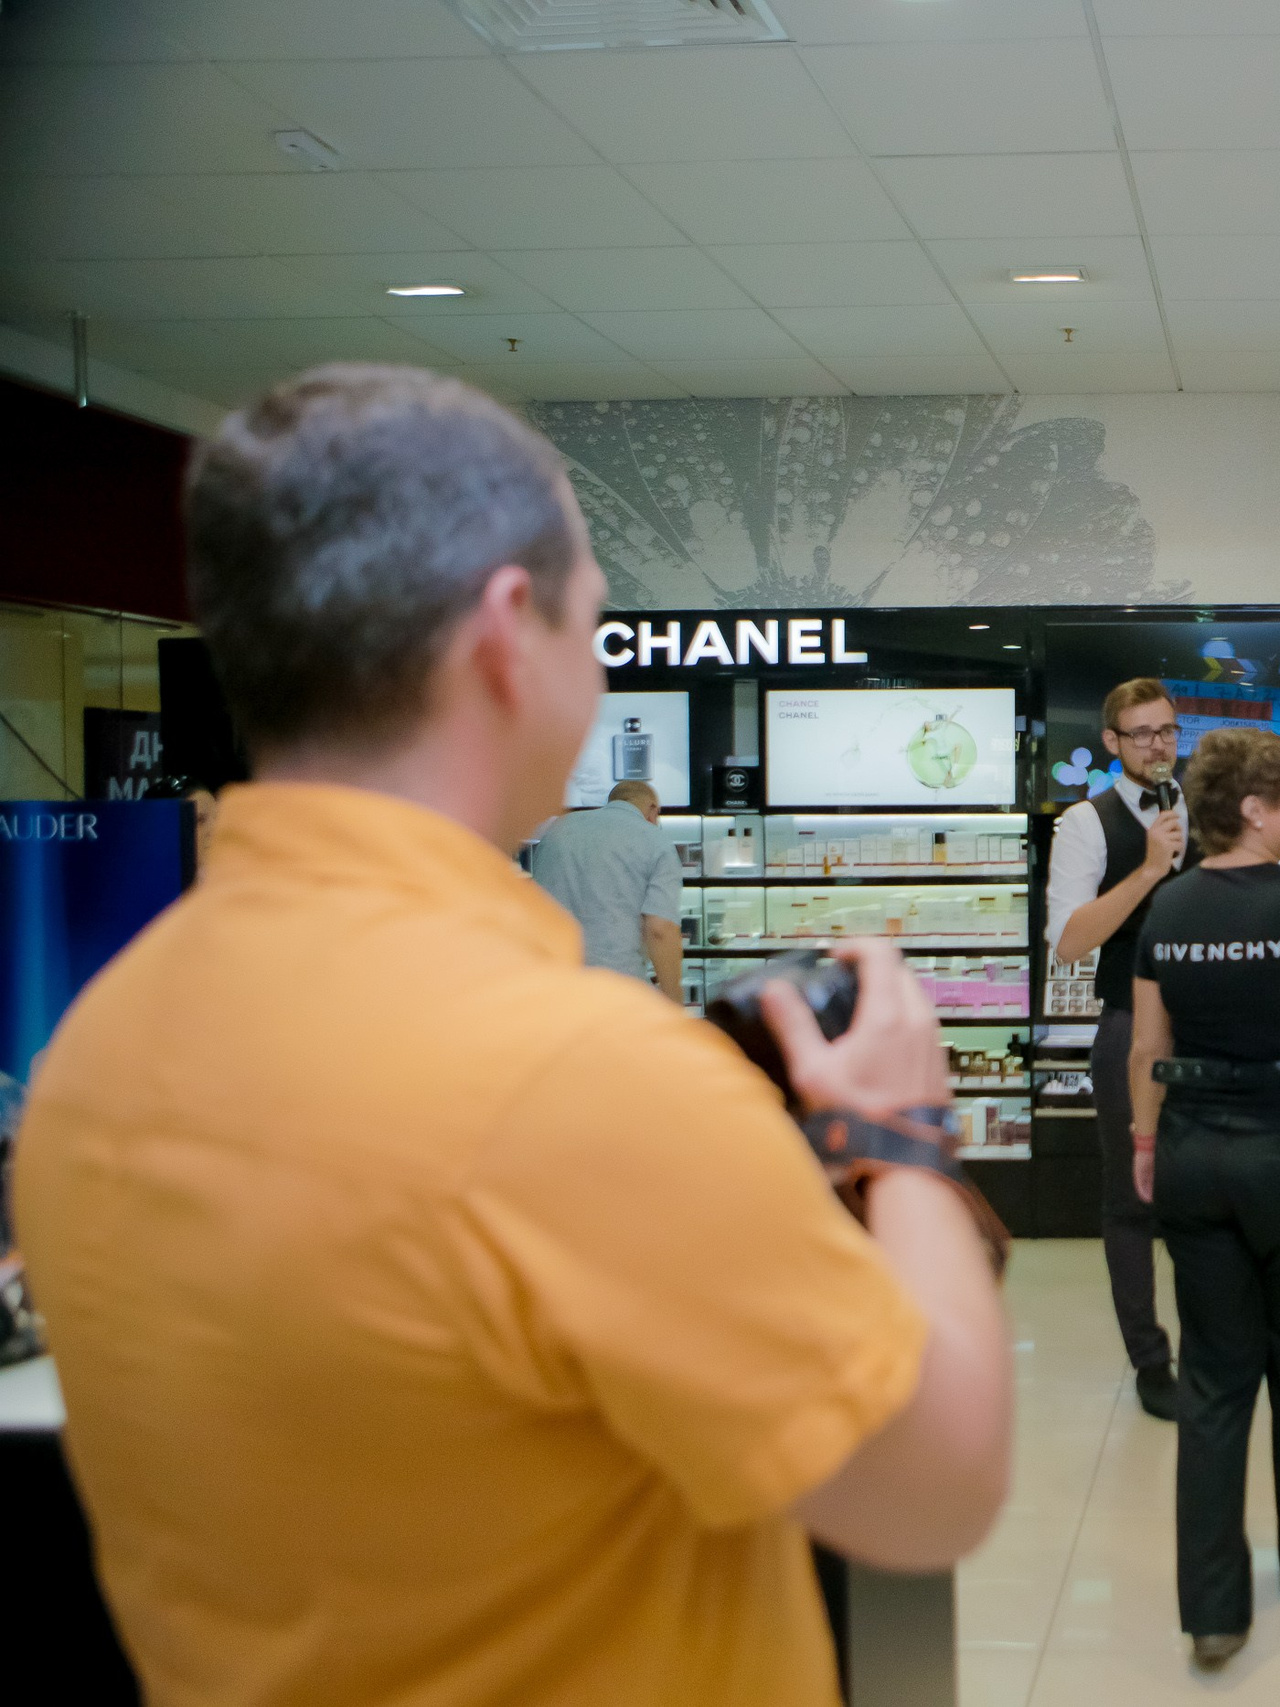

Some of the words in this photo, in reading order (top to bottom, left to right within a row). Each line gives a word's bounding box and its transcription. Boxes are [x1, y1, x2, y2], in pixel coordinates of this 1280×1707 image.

[591, 618, 868, 667] CHANEL
[779, 700, 820, 708] CHANCE
[778, 711, 820, 719] CHANEL
